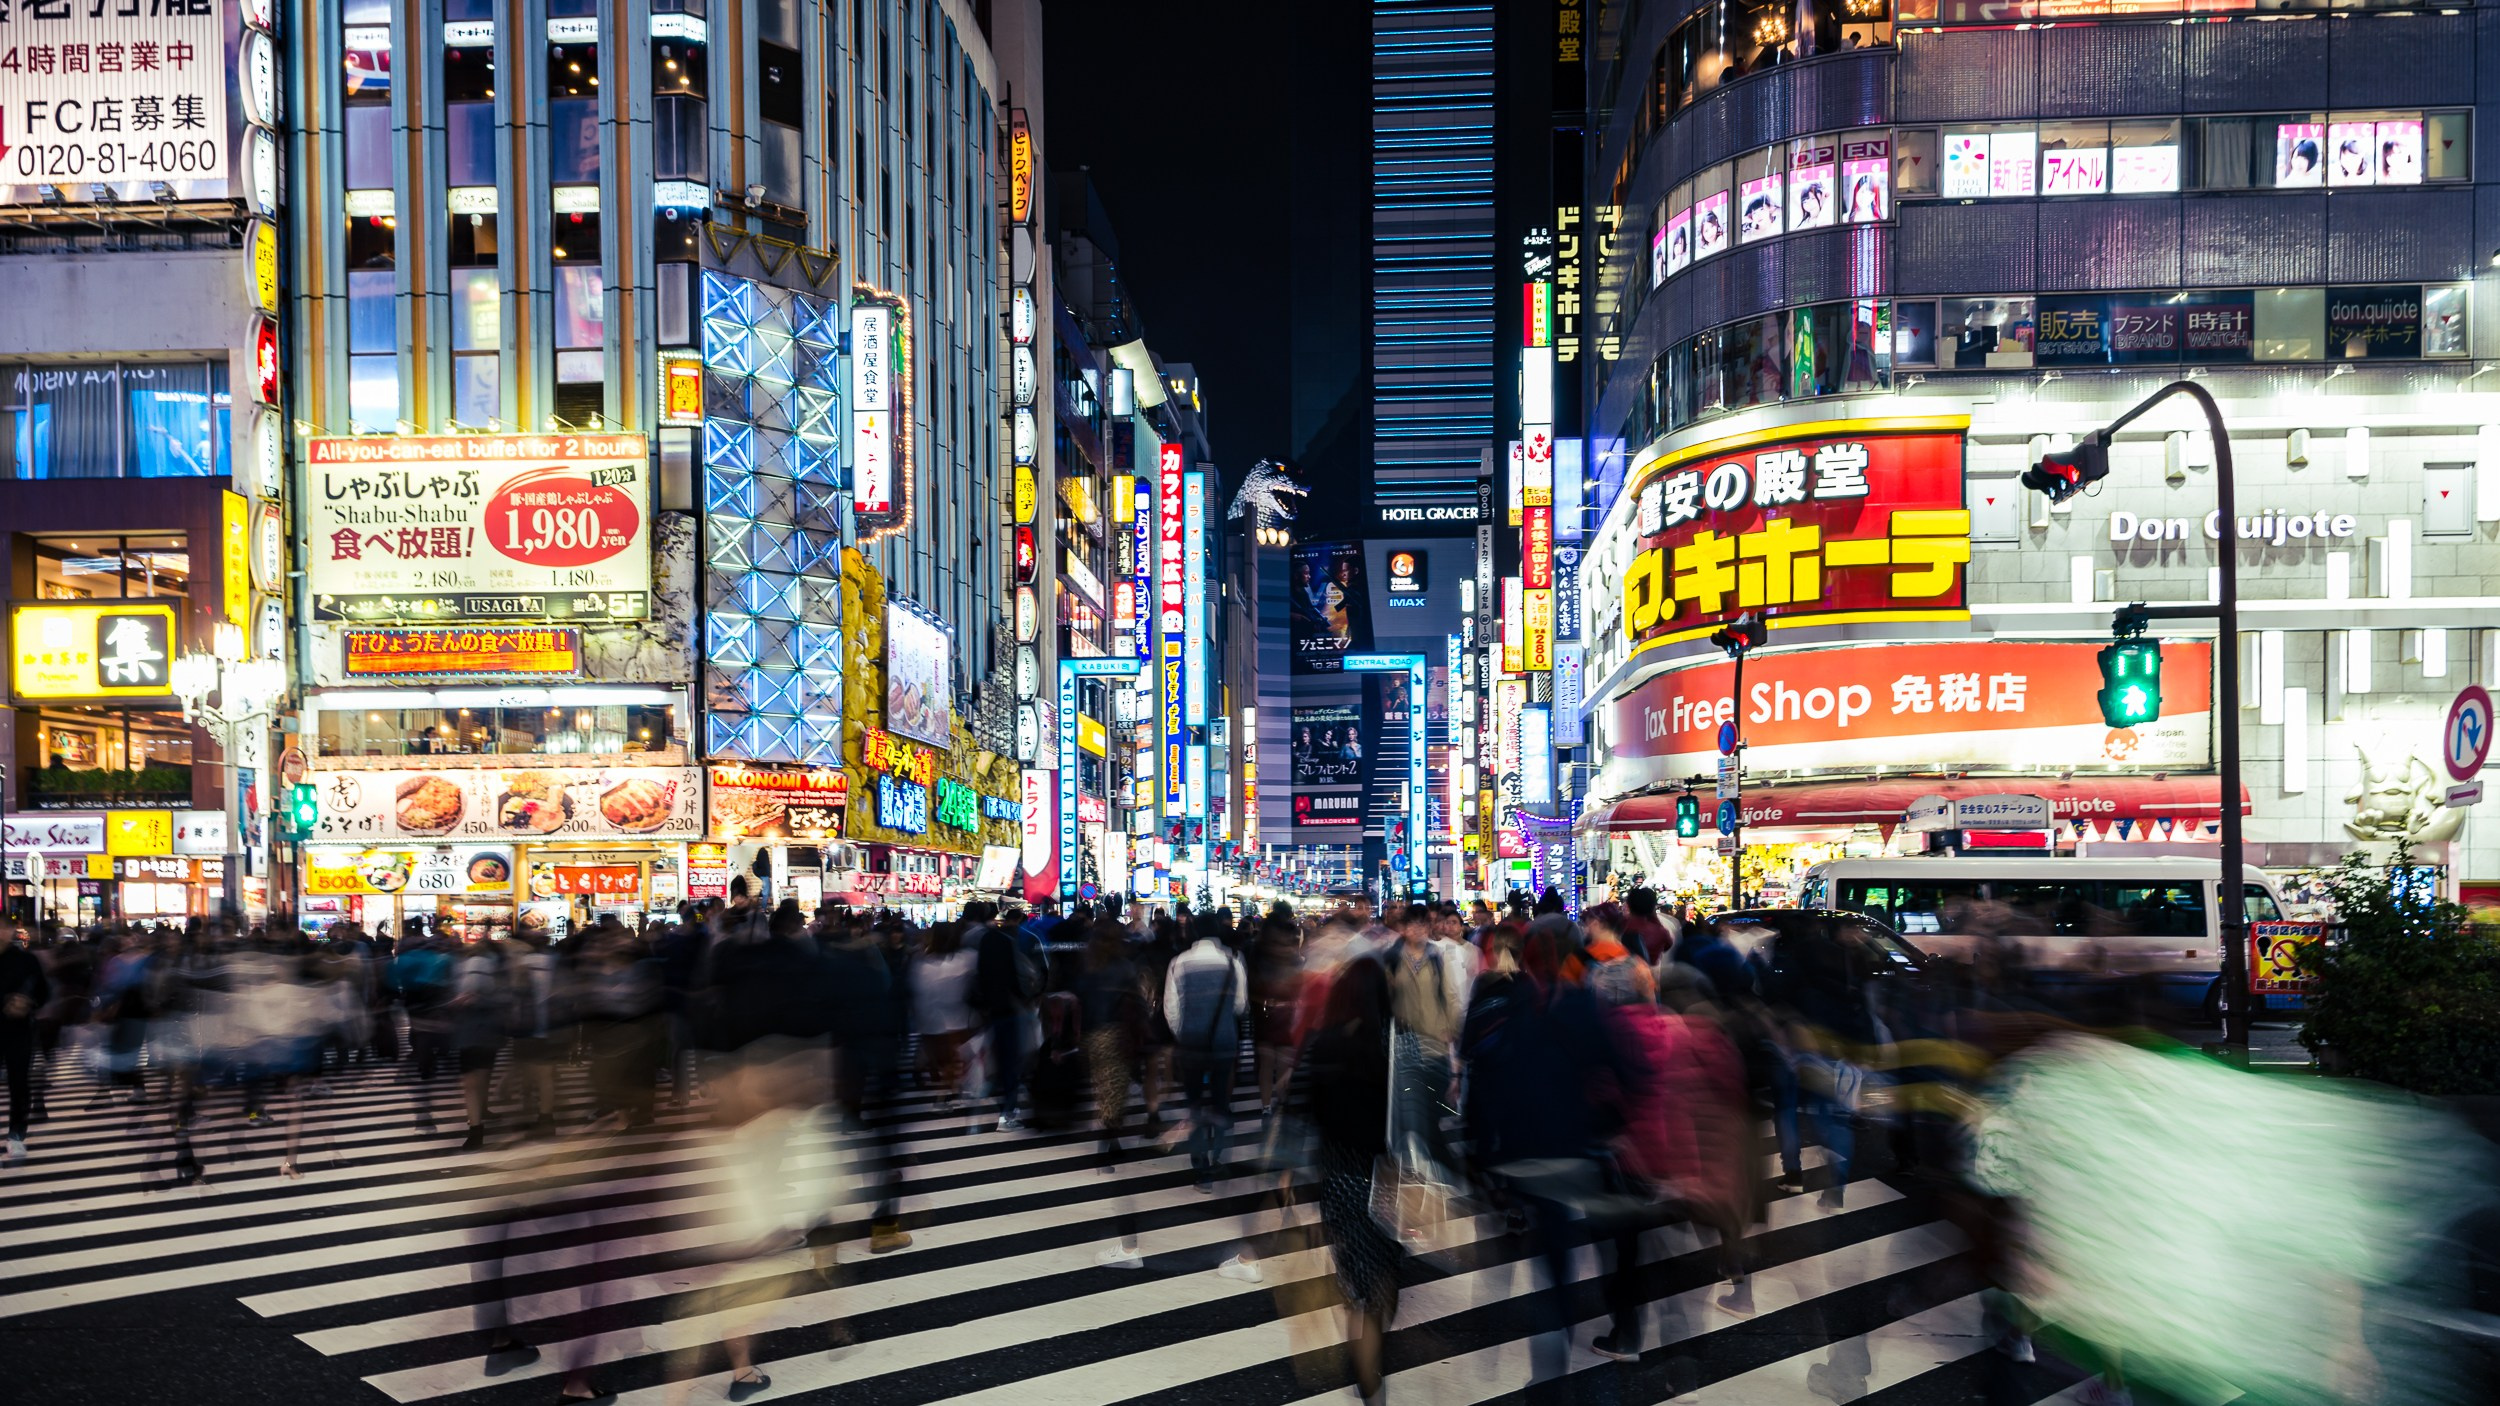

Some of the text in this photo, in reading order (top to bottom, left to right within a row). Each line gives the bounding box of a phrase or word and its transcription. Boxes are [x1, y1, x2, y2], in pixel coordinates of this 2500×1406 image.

[26, 94, 206, 134] FC店募集
[18, 139, 216, 177] 0120-81-4060
[1994, 160, 2032, 192] 新宿
[2039, 309, 2249, 340] 販売 ブランド 時計
[2331, 298, 2418, 325] don.quijote
[2115, 332, 2173, 350] BRAND
[2187, 331, 2248, 348] WATCH
[2329, 325, 2416, 345] ドン・キホーテ
[863, 317, 878, 404] 居酒屋食堂
[316, 438, 641, 462] All-you-can-eat buffet for 2 hours
[325, 470, 481, 501] しゃぶしゃぶ
[592, 466, 633, 486] 120分
[1382, 507, 1479, 520] HOTEL GRACER
[2110, 511, 2189, 542] Don
[505, 508, 627, 555] 1,980 yen
[607, 592, 645, 615] 5F
[1390, 598, 1426, 607] IMAX
[100, 617, 164, 682] 集
[1301, 637, 1352, 651] ジェミニマン
[1347, 658, 1386, 666] CENTRAL
[1890, 672, 2027, 715] 免税店
[1644, 679, 1872, 741] Tax Free Shop
[681, 769, 697, 816] かつ丼
[714, 770, 847, 789] OKONOMI YAKI
[1063, 694, 1073, 863] GODZILLA ROAD
[1027, 775, 1038, 835] トラノコ
